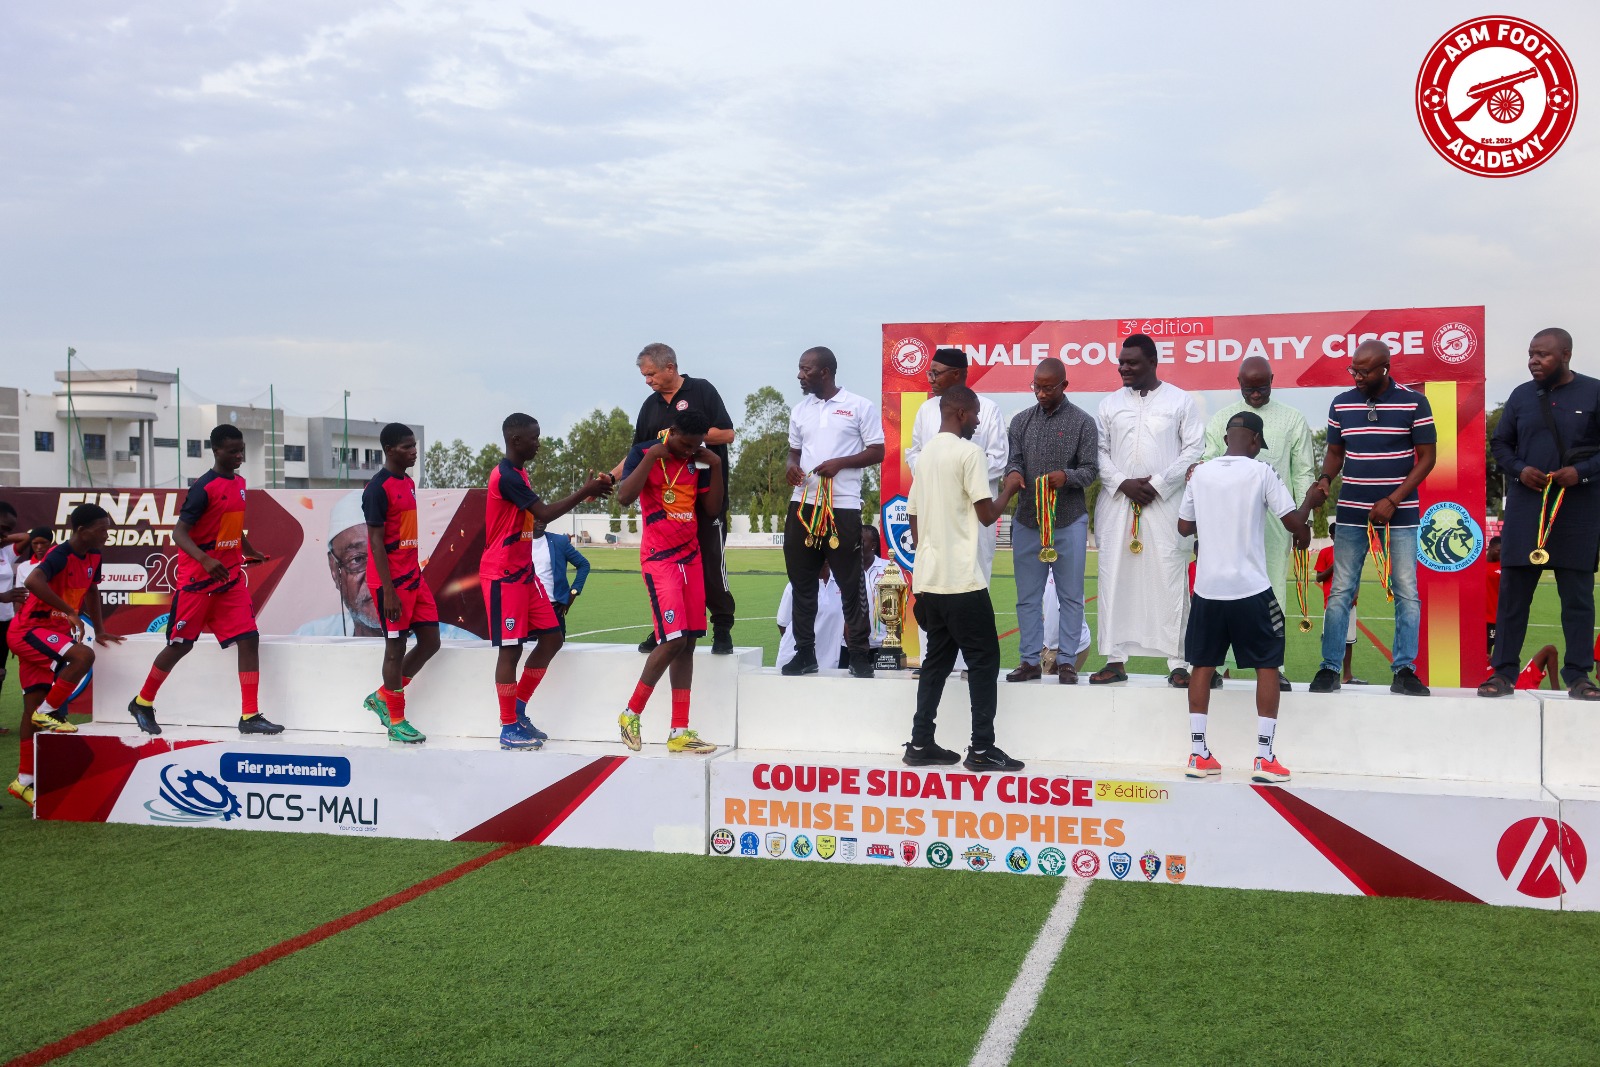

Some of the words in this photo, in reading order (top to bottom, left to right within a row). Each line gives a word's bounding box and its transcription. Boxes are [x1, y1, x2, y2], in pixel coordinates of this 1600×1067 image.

[1141, 320, 1204, 335] édition
[1440, 324, 1452, 334] ABM
[1454, 324, 1470, 333] FOOT
[936, 343, 1050, 366] NALE
[1185, 336, 1313, 364] SIDATY
[1441, 352, 1468, 362] ACADEMY
[1424, 503, 1447, 524] COMPLEXE
[1449, 503, 1470, 524] SCOLAIRE
[1474, 539, 1482, 555] SPORT
[107, 574, 145, 582] JUILLET
[101, 592, 130, 605] 16H
[237, 761, 264, 775] Fier
[265, 763, 337, 777] partenaire
[753, 764, 861, 795] COUPE
[866, 769, 991, 802] SIDATY
[996, 775, 1093, 807] CISSE
[1114, 783, 1169, 800] édition
[247, 792, 378, 825] DCS-MALI
[724, 797, 854, 831] REMISE
[861, 805, 926, 837] DES
[931, 809, 1126, 848] TROPHEES
[868, 847, 893, 857] ELITE
